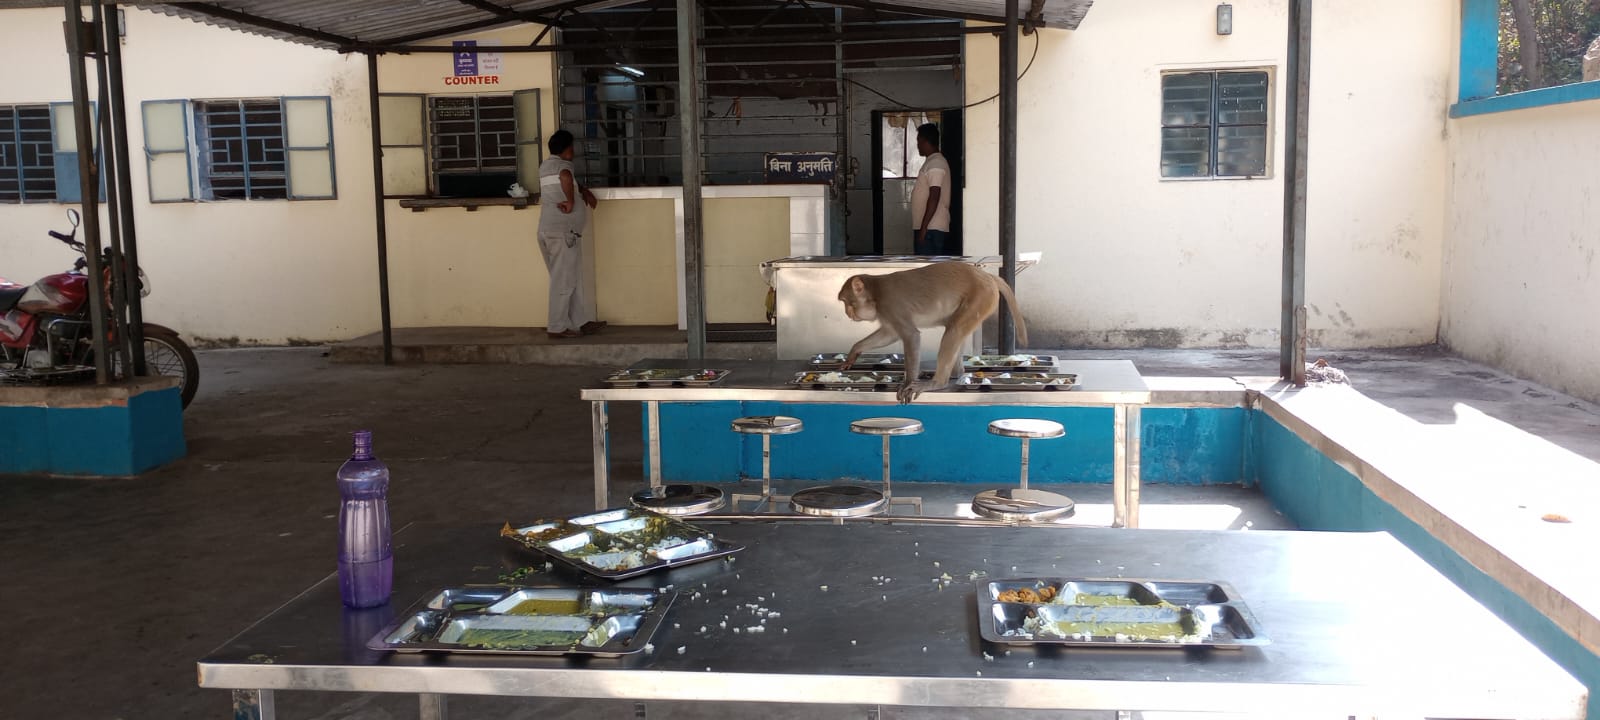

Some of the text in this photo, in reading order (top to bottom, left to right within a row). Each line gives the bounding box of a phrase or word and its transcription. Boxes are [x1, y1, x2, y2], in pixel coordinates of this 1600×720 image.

[445, 76, 499, 85] COUNTER
[769, 157, 833, 176] बिना अनुमति
